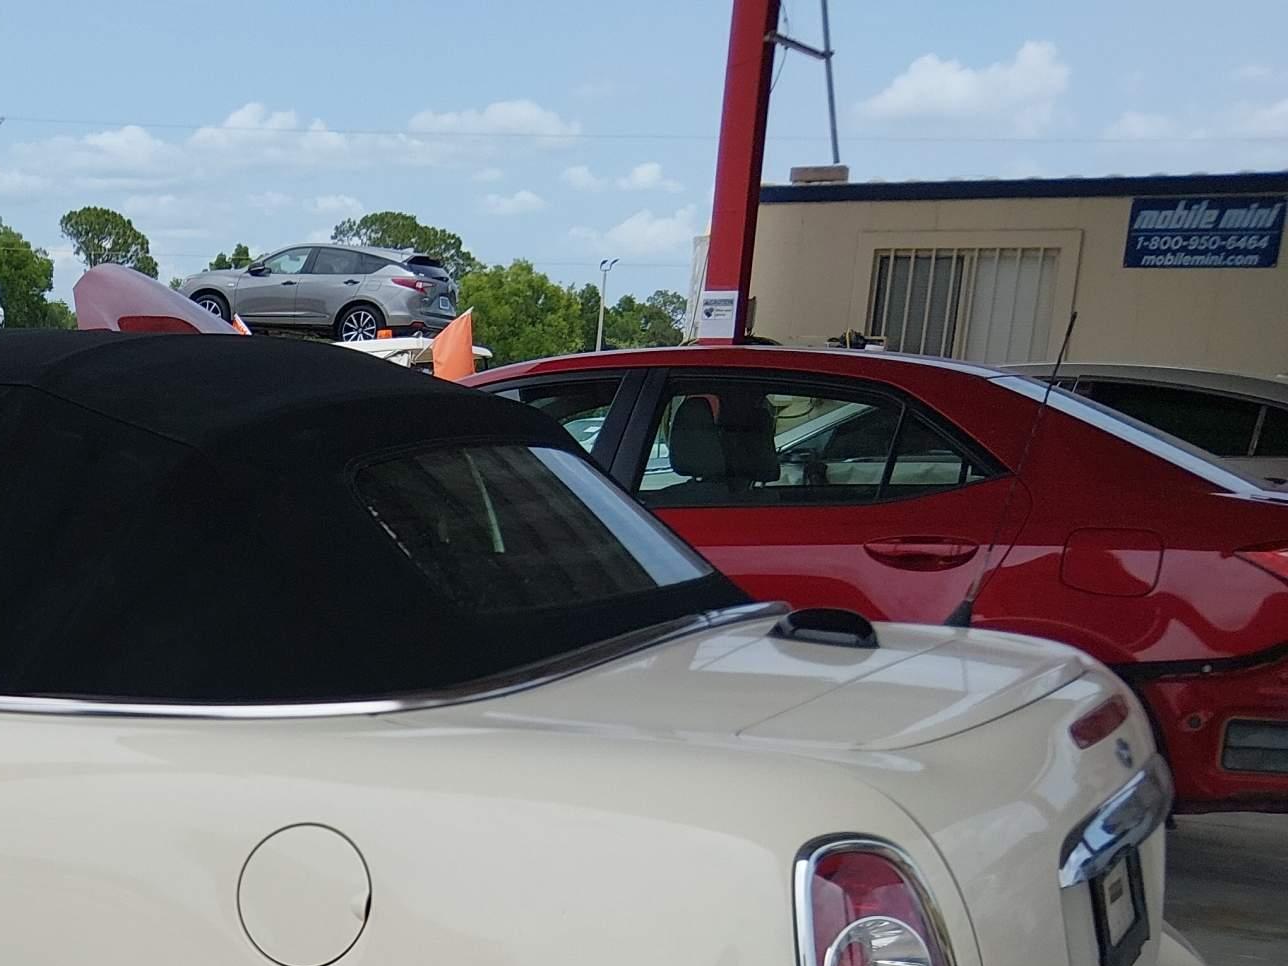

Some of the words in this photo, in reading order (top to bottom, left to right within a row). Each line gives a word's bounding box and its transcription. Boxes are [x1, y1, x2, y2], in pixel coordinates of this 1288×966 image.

[1134, 200, 1219, 229] mobile
[1219, 203, 1283, 229] mini
[1135, 235, 1270, 250] 1-800-950-6464
[1140, 252, 1260, 266] mobilemini.com
